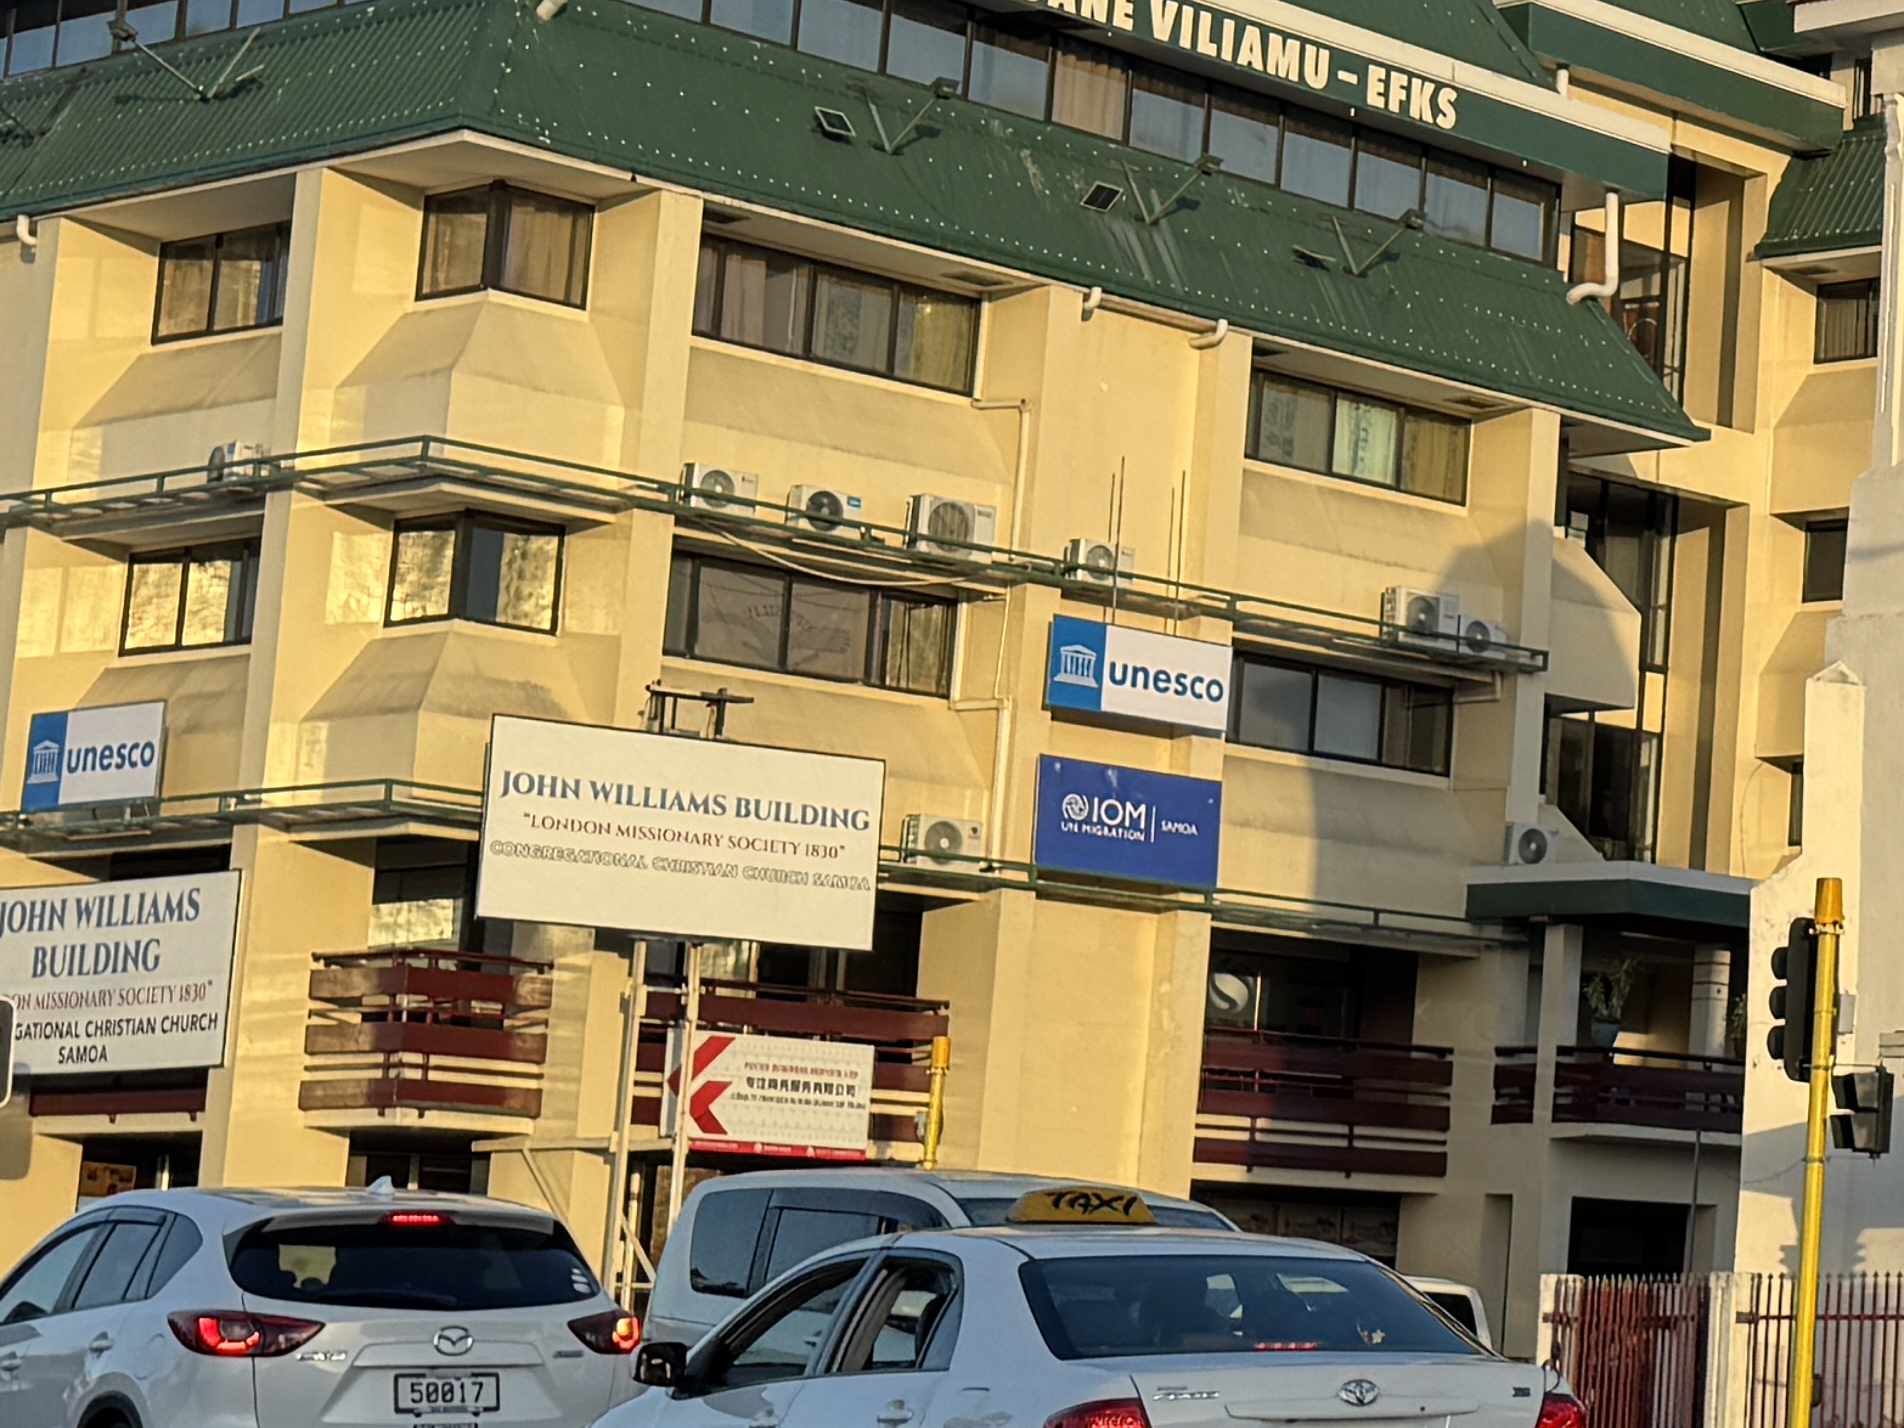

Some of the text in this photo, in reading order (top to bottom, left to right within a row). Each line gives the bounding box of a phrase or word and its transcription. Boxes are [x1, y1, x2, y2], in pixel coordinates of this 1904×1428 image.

[1109, 660, 1224, 703] unesco
[66, 740, 155, 775] unesco
[500, 770, 871, 832] JOHN WILLIAMS BUILDING
[1091, 796, 1147, 830] IOM
[523, 812, 611, 835] "LONDON
[615, 824, 724, 848] MISSIONARY
[727, 835, 800, 856] SOCIETY
[1082, 823, 1145, 842] MIGRATION
[0, 887, 201, 939] JOHN WILLIAMS
[32, 938, 161, 978] BUILDING
[34, 989, 115, 1011] MISSIONARY
[117, 985, 176, 1006] SOCIETY
[15, 1012, 219, 1041] GATIONAL CHRISTIAN CHURCH
[58, 1044, 108, 1064] SAMOA
[1044, 1190, 1138, 1217] TAXI
[410, 1381, 484, 1404] 50017
